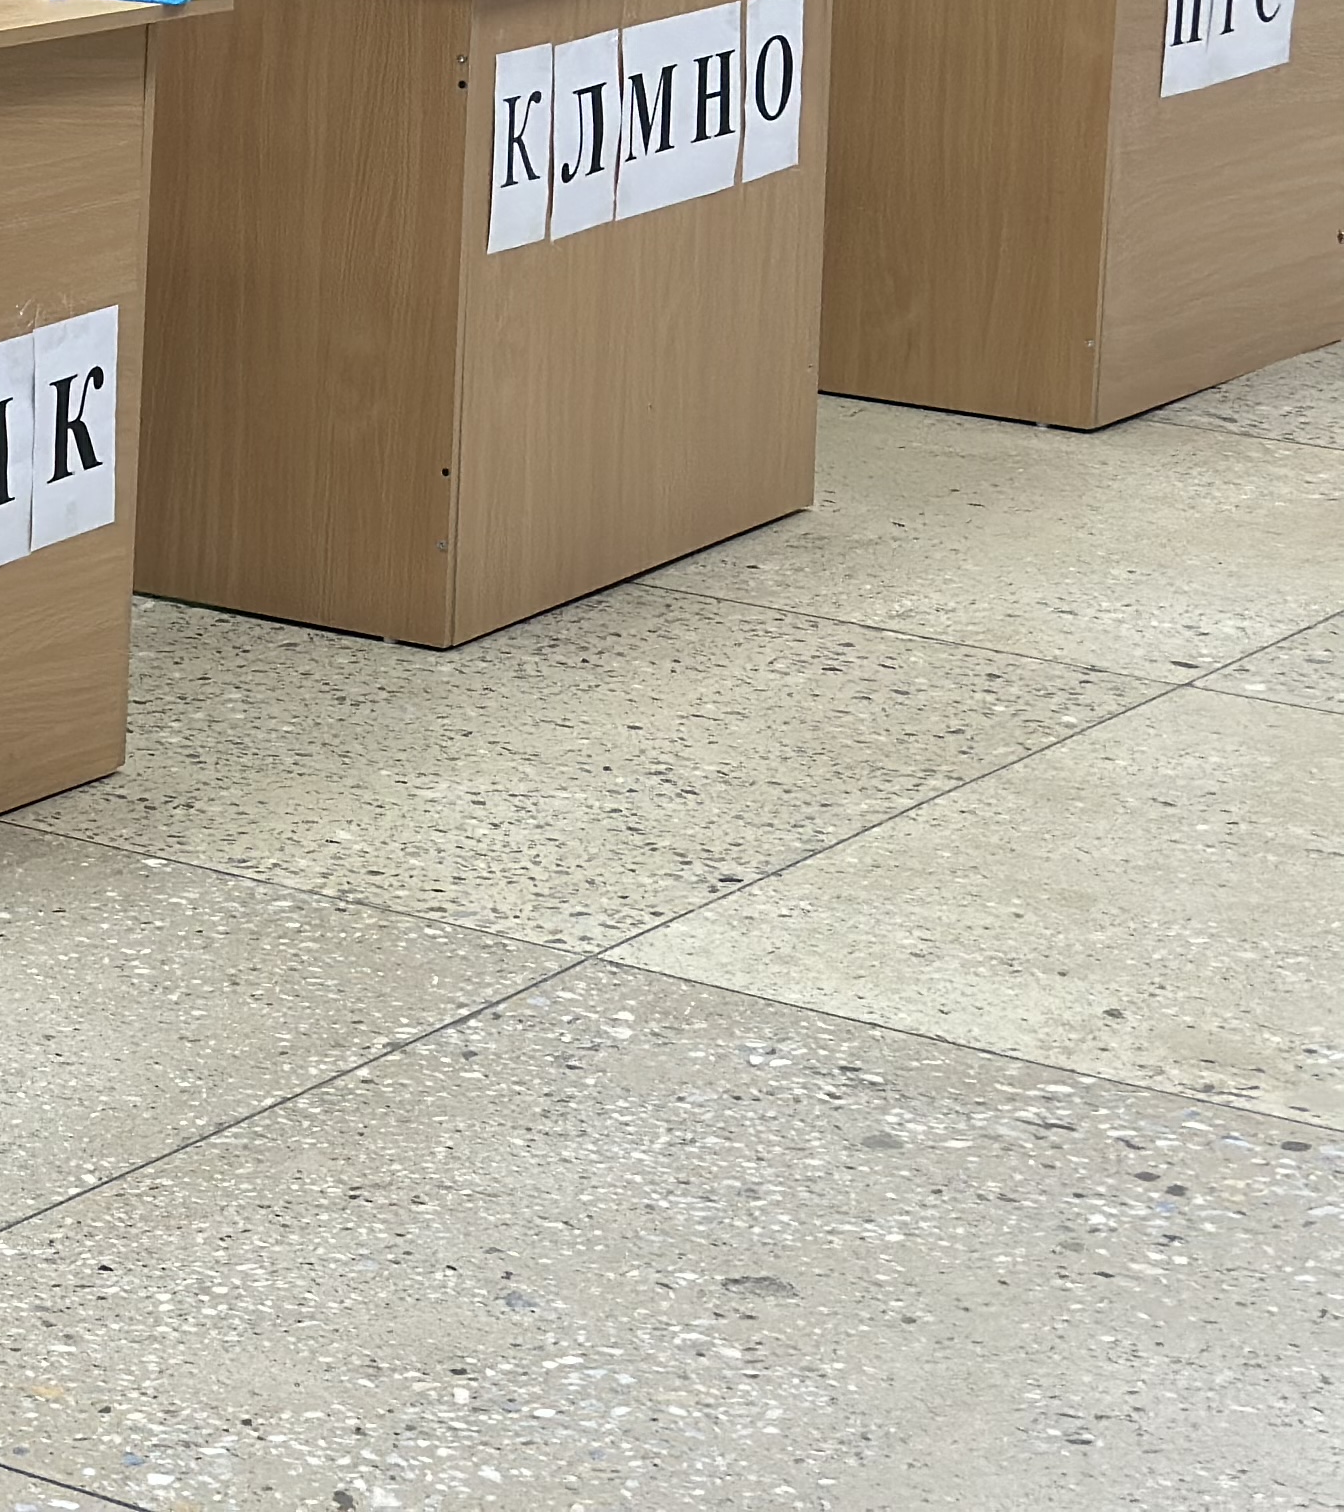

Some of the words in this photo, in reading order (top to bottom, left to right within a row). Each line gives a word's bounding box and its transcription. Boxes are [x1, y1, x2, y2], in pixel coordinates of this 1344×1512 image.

[501, 90, 543, 189] К
[561, 81, 607, 184] Л
[625, 63, 676, 162] М
[691, 49, 736, 144] Н
[754, 34, 794, 121] О
[47, 365, 105, 484] К
